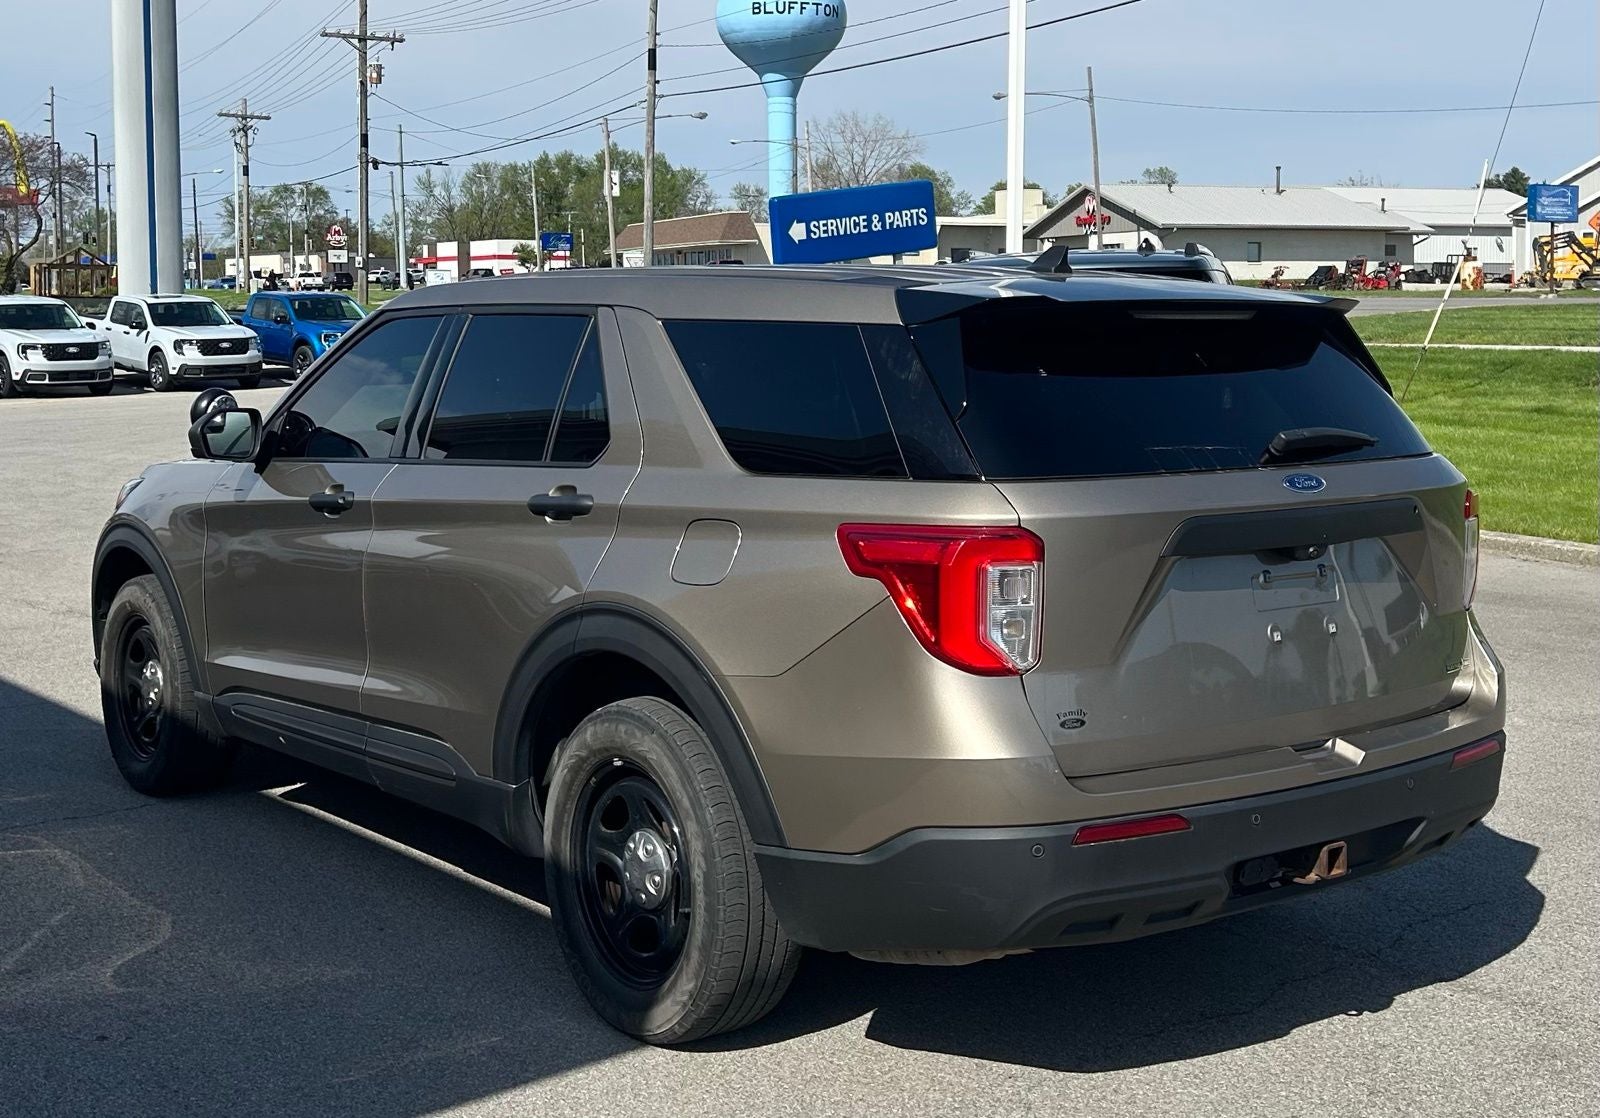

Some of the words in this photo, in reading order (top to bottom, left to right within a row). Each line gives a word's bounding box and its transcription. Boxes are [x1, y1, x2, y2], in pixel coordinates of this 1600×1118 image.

[752, 1, 839, 18] BLUFFTON
[810, 215, 869, 239] SERVICE
[871, 214, 882, 231] &
[885, 207, 928, 230] PARTS
[1294, 476, 1319, 488] Ford
[1056, 709, 1088, 720] Family
